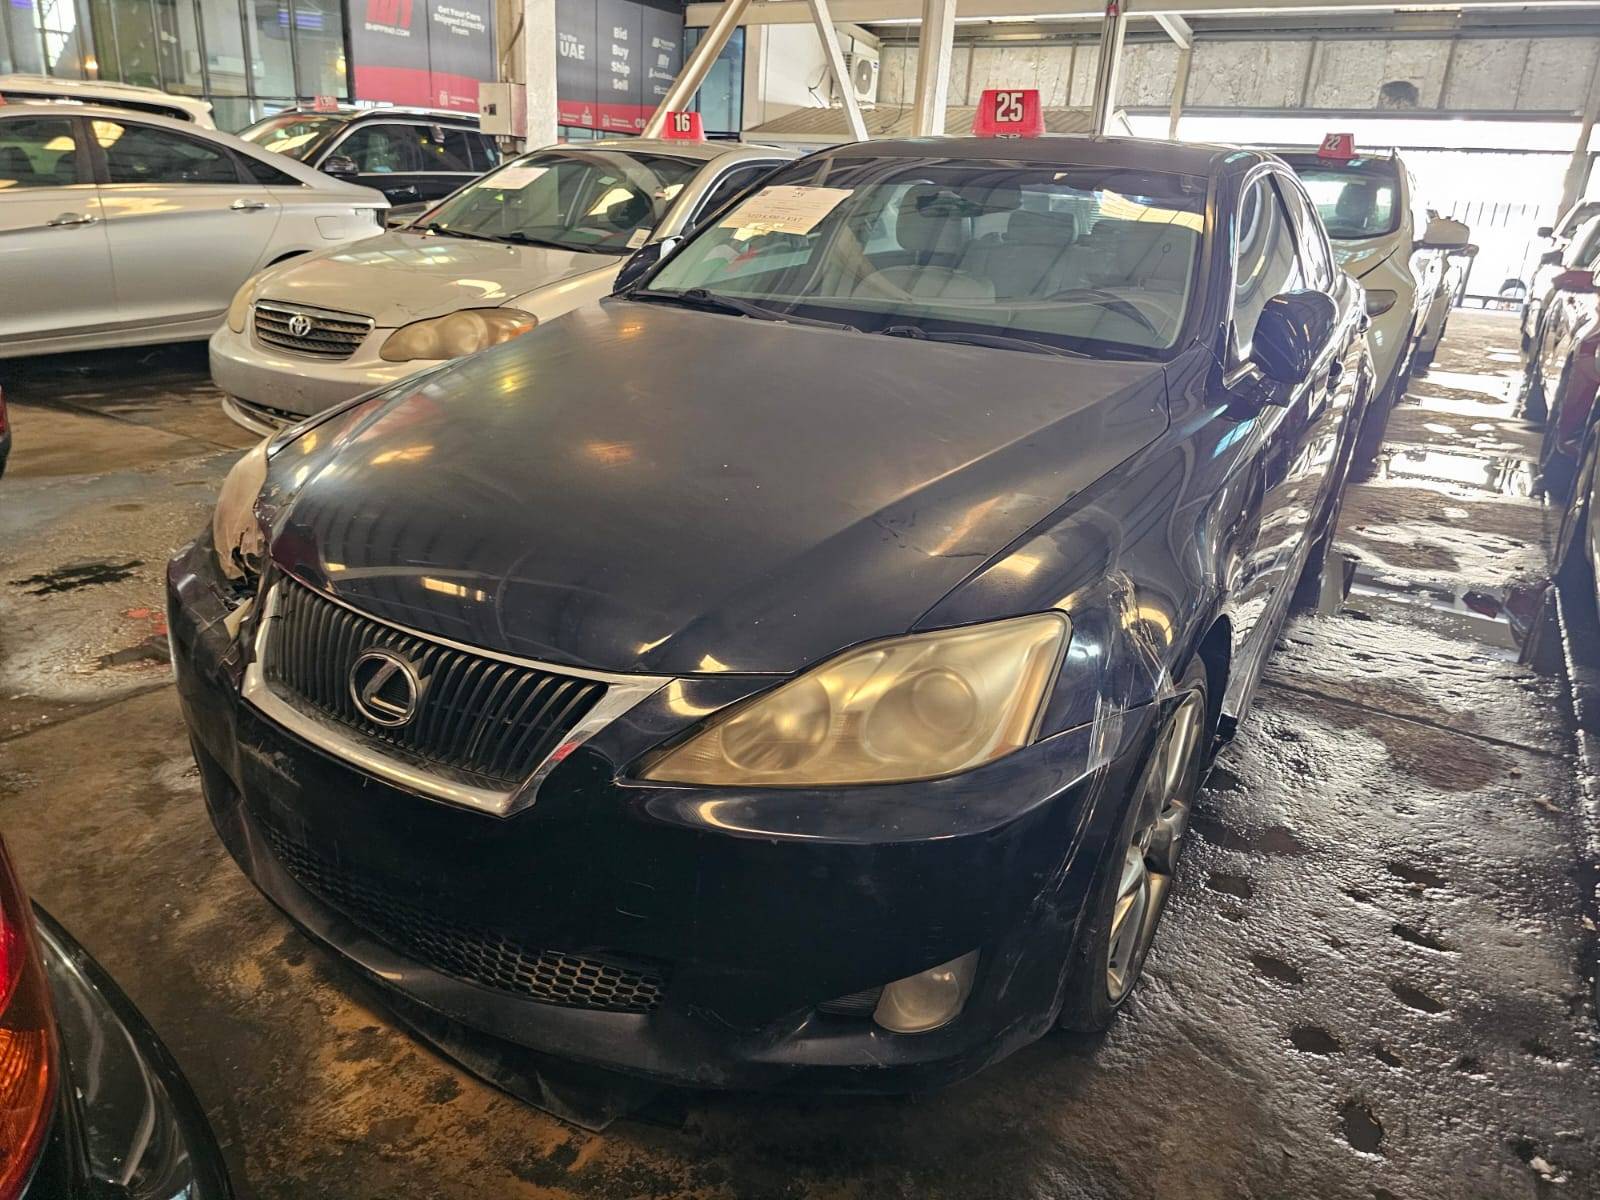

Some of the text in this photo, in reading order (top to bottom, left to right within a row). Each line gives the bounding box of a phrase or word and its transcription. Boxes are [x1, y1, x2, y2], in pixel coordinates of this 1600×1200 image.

[613, 27, 628, 40] Bid
[559, 41, 585, 60] UAE
[612, 44, 629, 60] Buy
[611, 61, 630, 77] Ship
[613, 78, 628, 91] Sell
[996, 92, 1023, 122] 25
[674, 113, 691, 132] 16
[1325, 135, 1341, 151] 22
